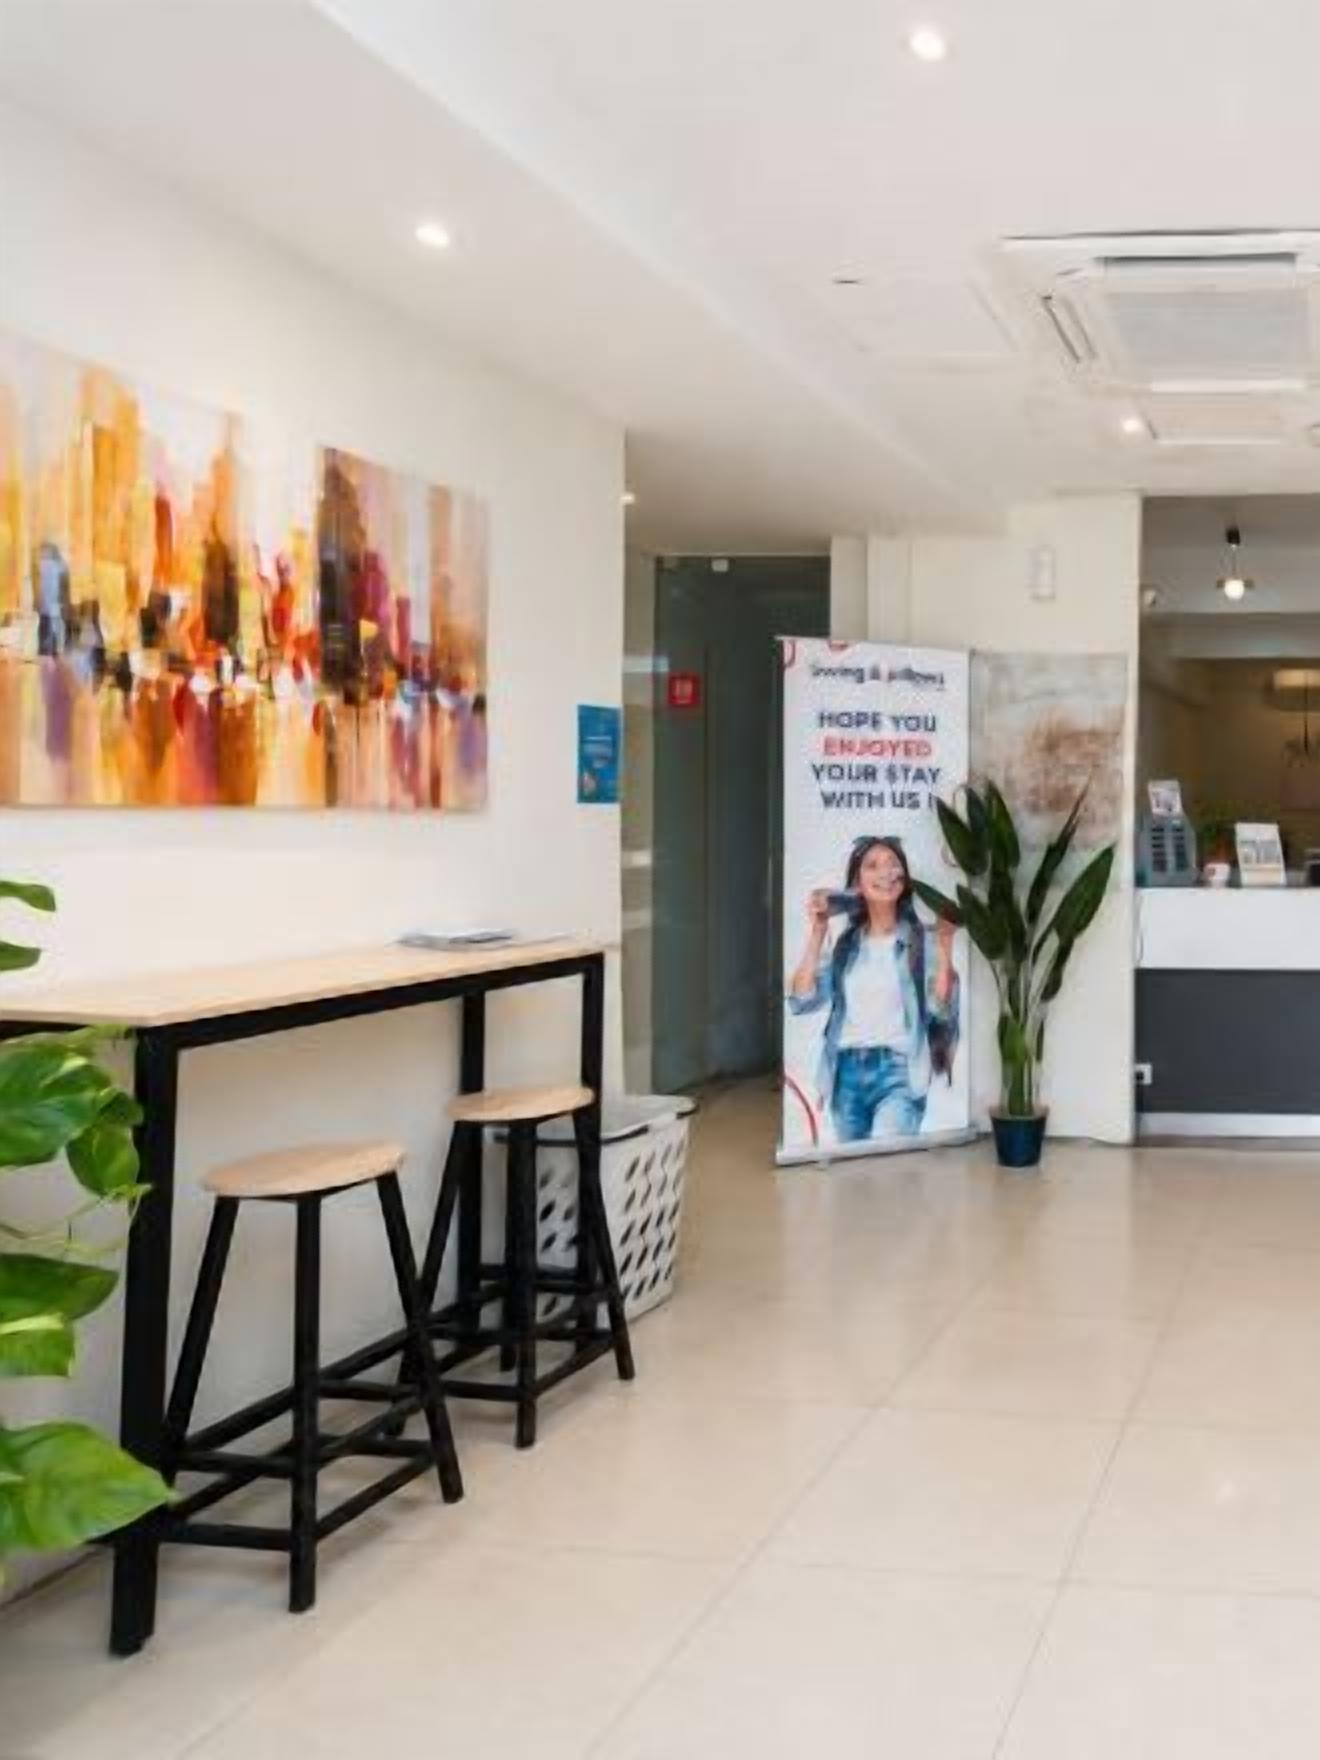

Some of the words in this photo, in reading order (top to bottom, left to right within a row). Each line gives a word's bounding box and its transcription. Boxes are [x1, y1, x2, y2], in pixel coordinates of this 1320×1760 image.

[819, 711, 880, 729] HOPE
[889, 714, 936, 732] YOU
[824, 738, 933, 756] ENJOYED
[812, 764, 877, 783] YOUR
[886, 766, 941, 784] STAY
[821, 791, 884, 809] WITH
